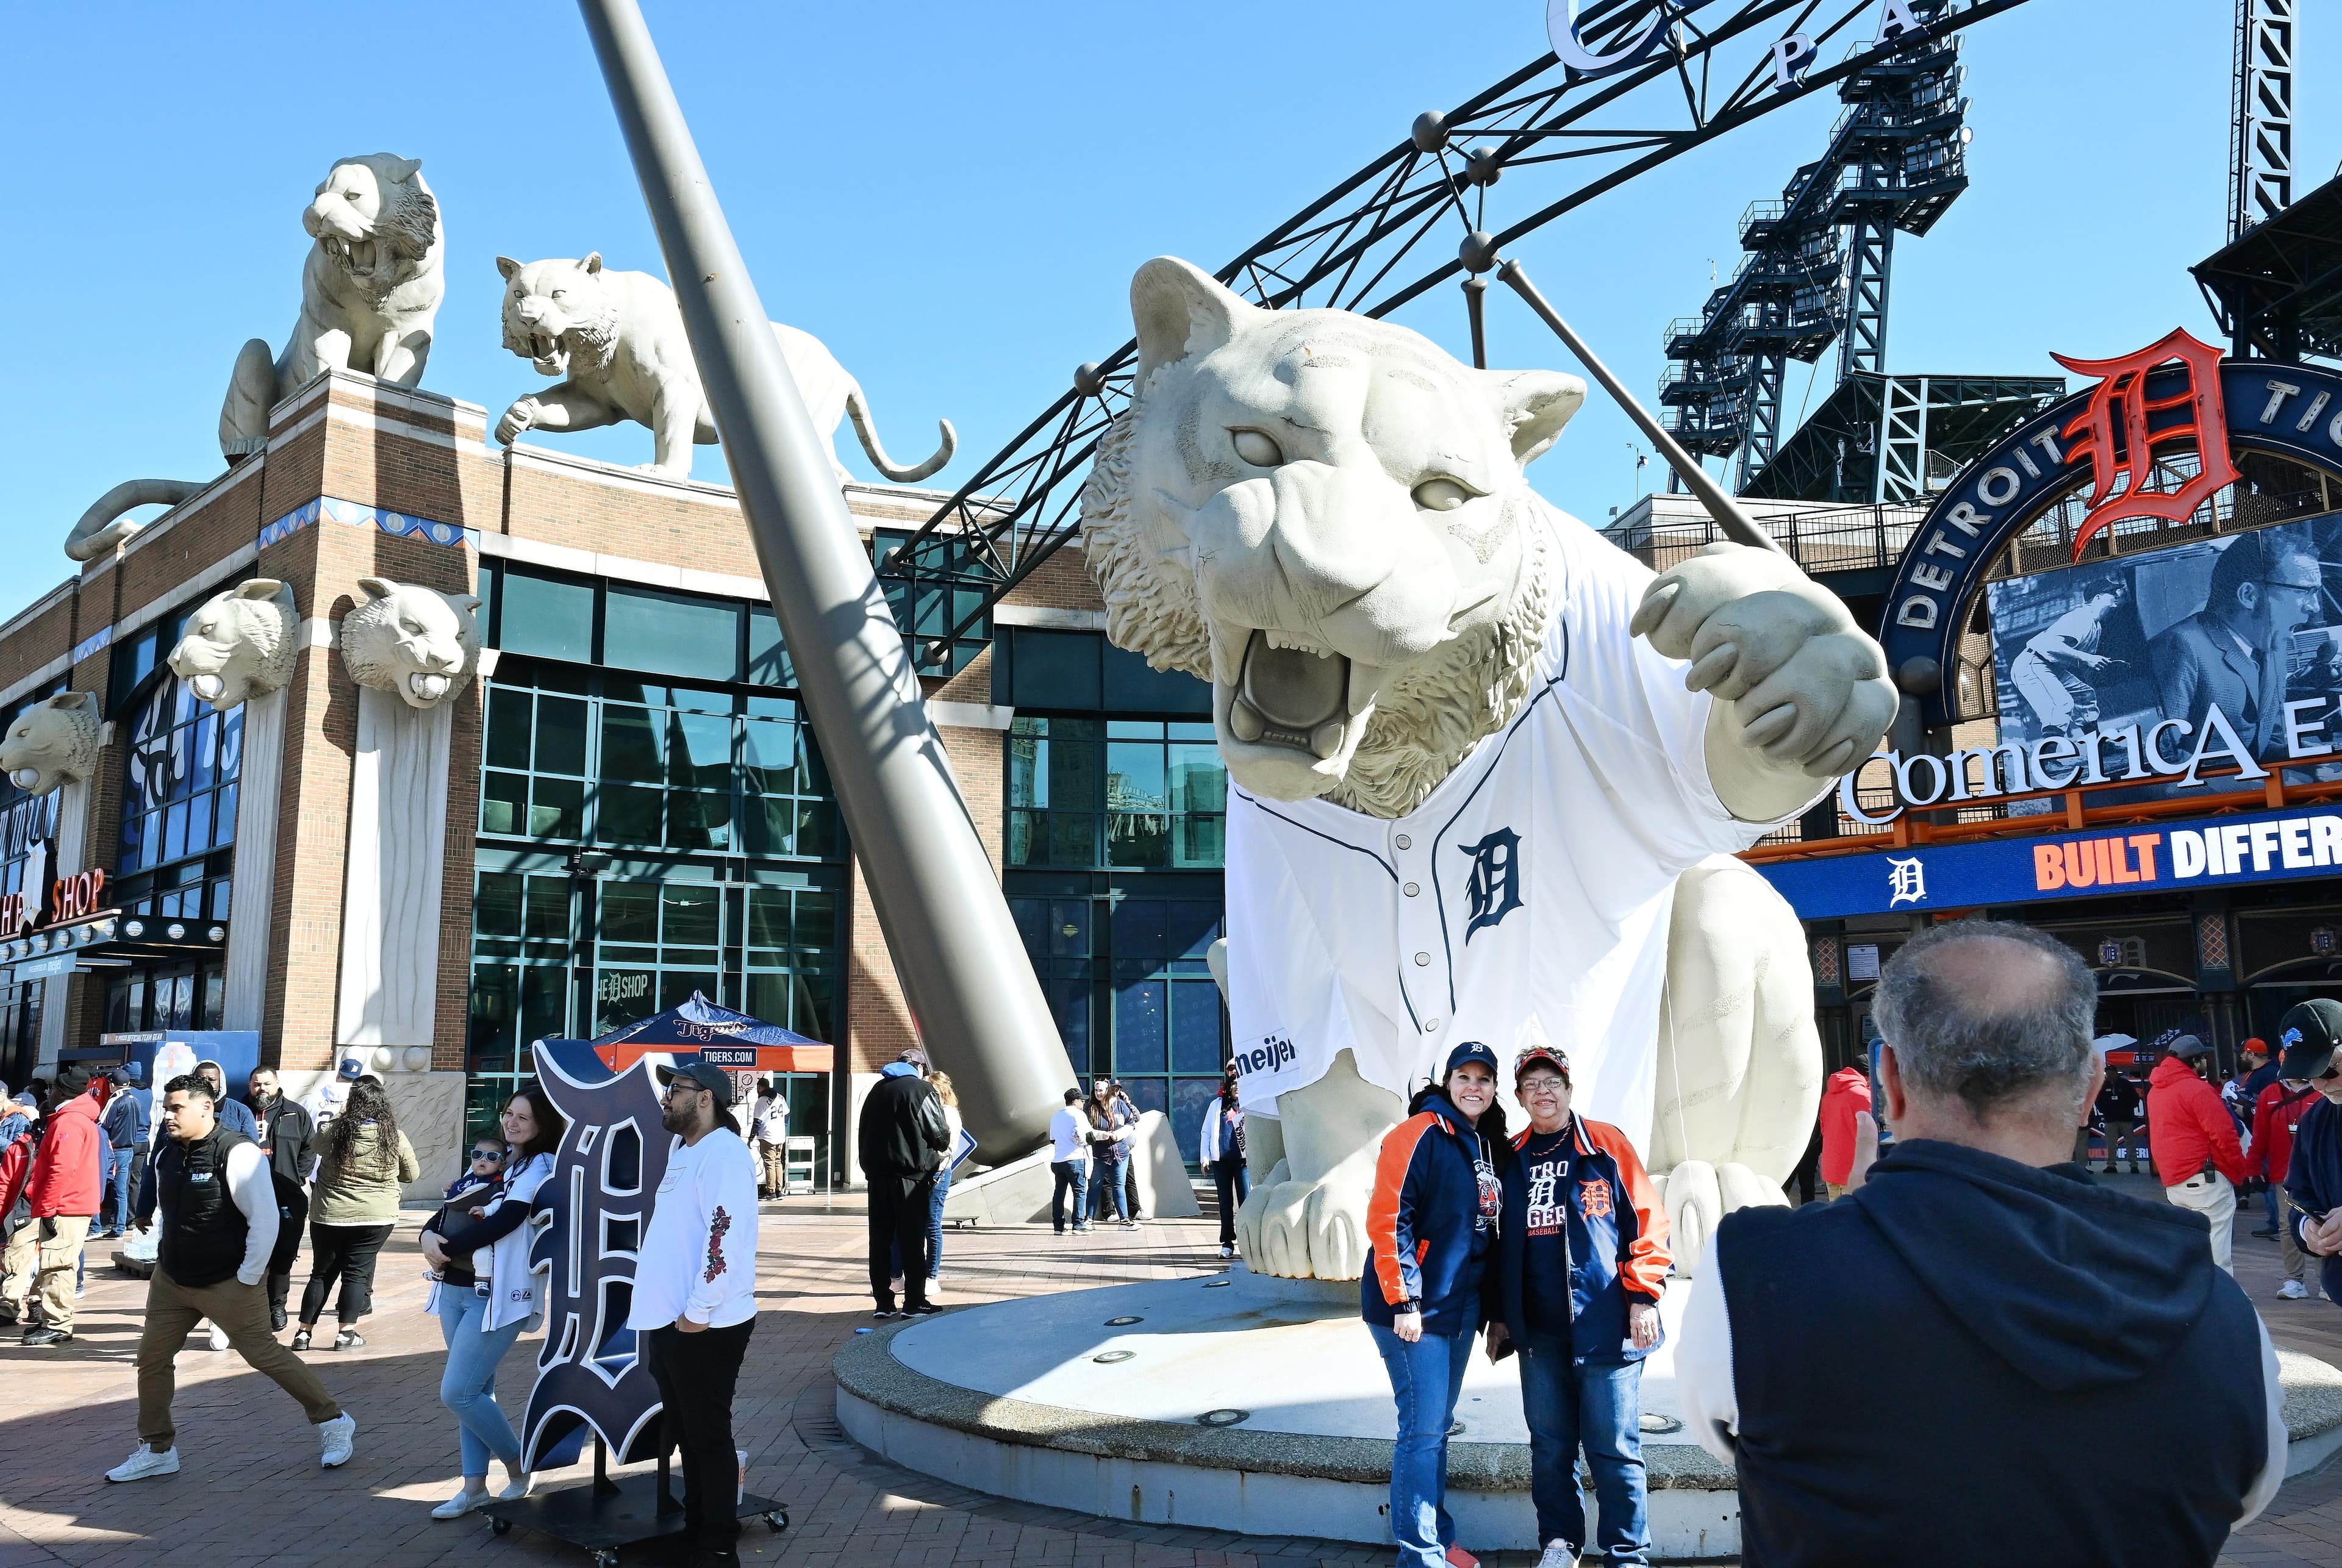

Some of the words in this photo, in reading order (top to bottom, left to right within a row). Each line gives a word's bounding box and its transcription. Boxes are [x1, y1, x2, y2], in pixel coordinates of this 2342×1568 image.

[2049, 326, 2243, 565] D
[1896, 424, 2064, 629] DETROIT
[2033, 832, 2161, 891] BUILT
[2170, 815, 2342, 879] DIFFER
[52, 867, 105, 923] SHOP
[1457, 826, 1525, 947] D
[621, 975, 648, 998] SHOP
[704, 1051, 753, 1063] TIGERS.COM
[1578, 1178, 1612, 1223] D
[1527, 1226, 1560, 1237] BASEBALL
